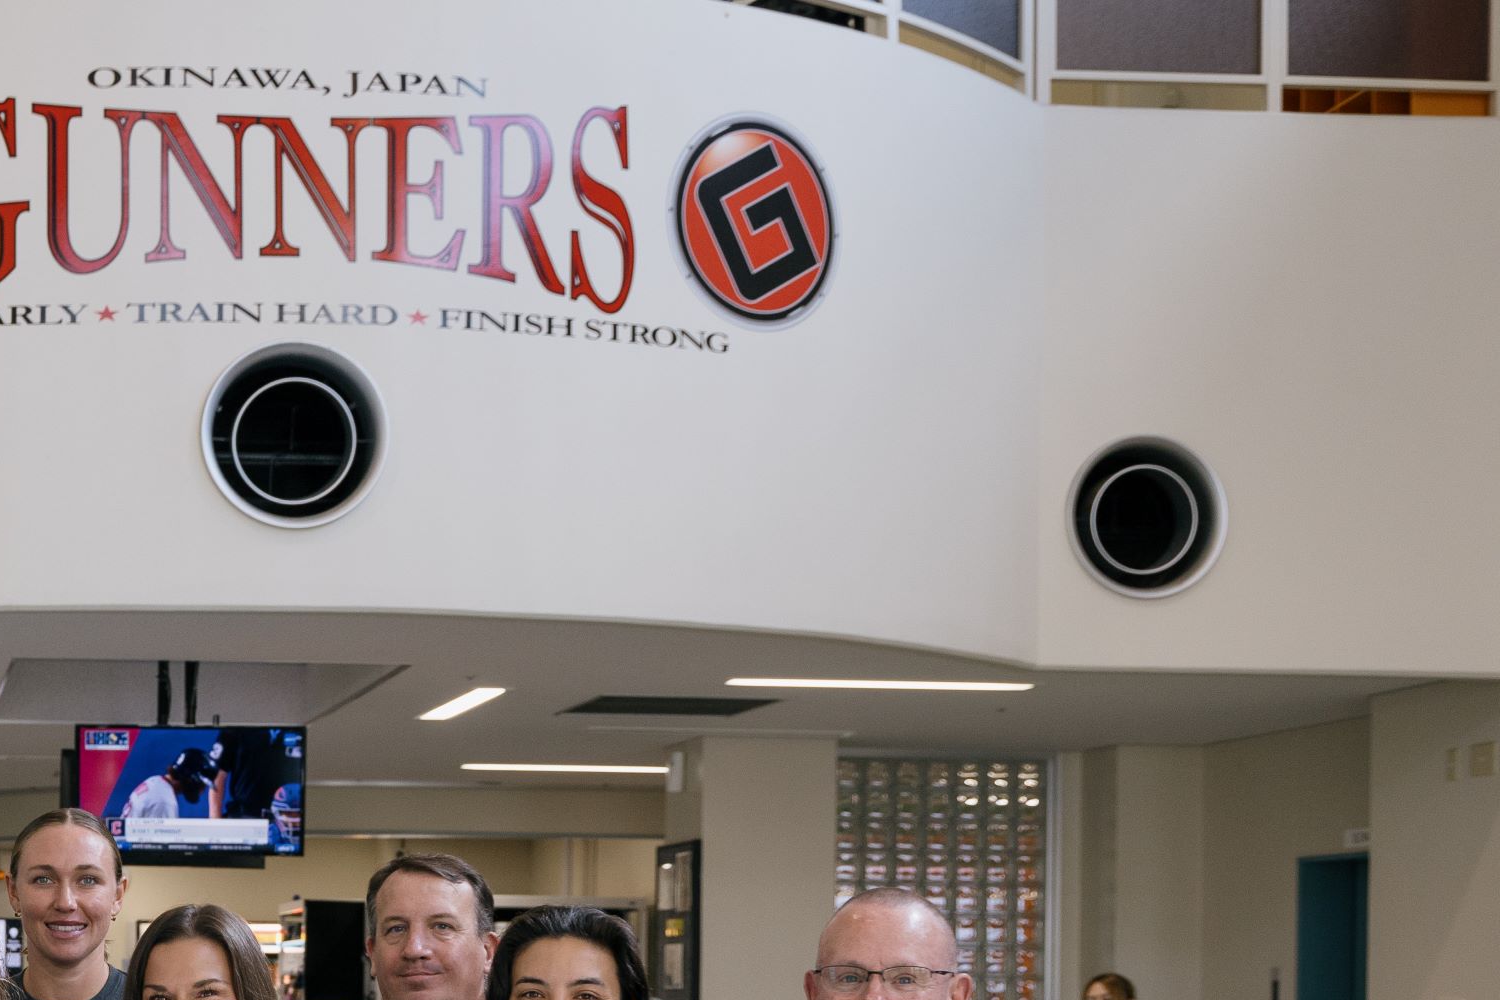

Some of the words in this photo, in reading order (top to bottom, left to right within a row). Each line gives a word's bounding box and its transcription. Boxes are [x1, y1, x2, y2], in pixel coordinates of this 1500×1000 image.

[87, 66, 331, 95] OKINAWA,
[343, 71, 489, 98] JAPAN
[126, 302, 263, 323] TRAIN
[274, 302, 398, 326] HARD
[439, 307, 573, 338] FINISH
[585, 319, 730, 353] STRONG
